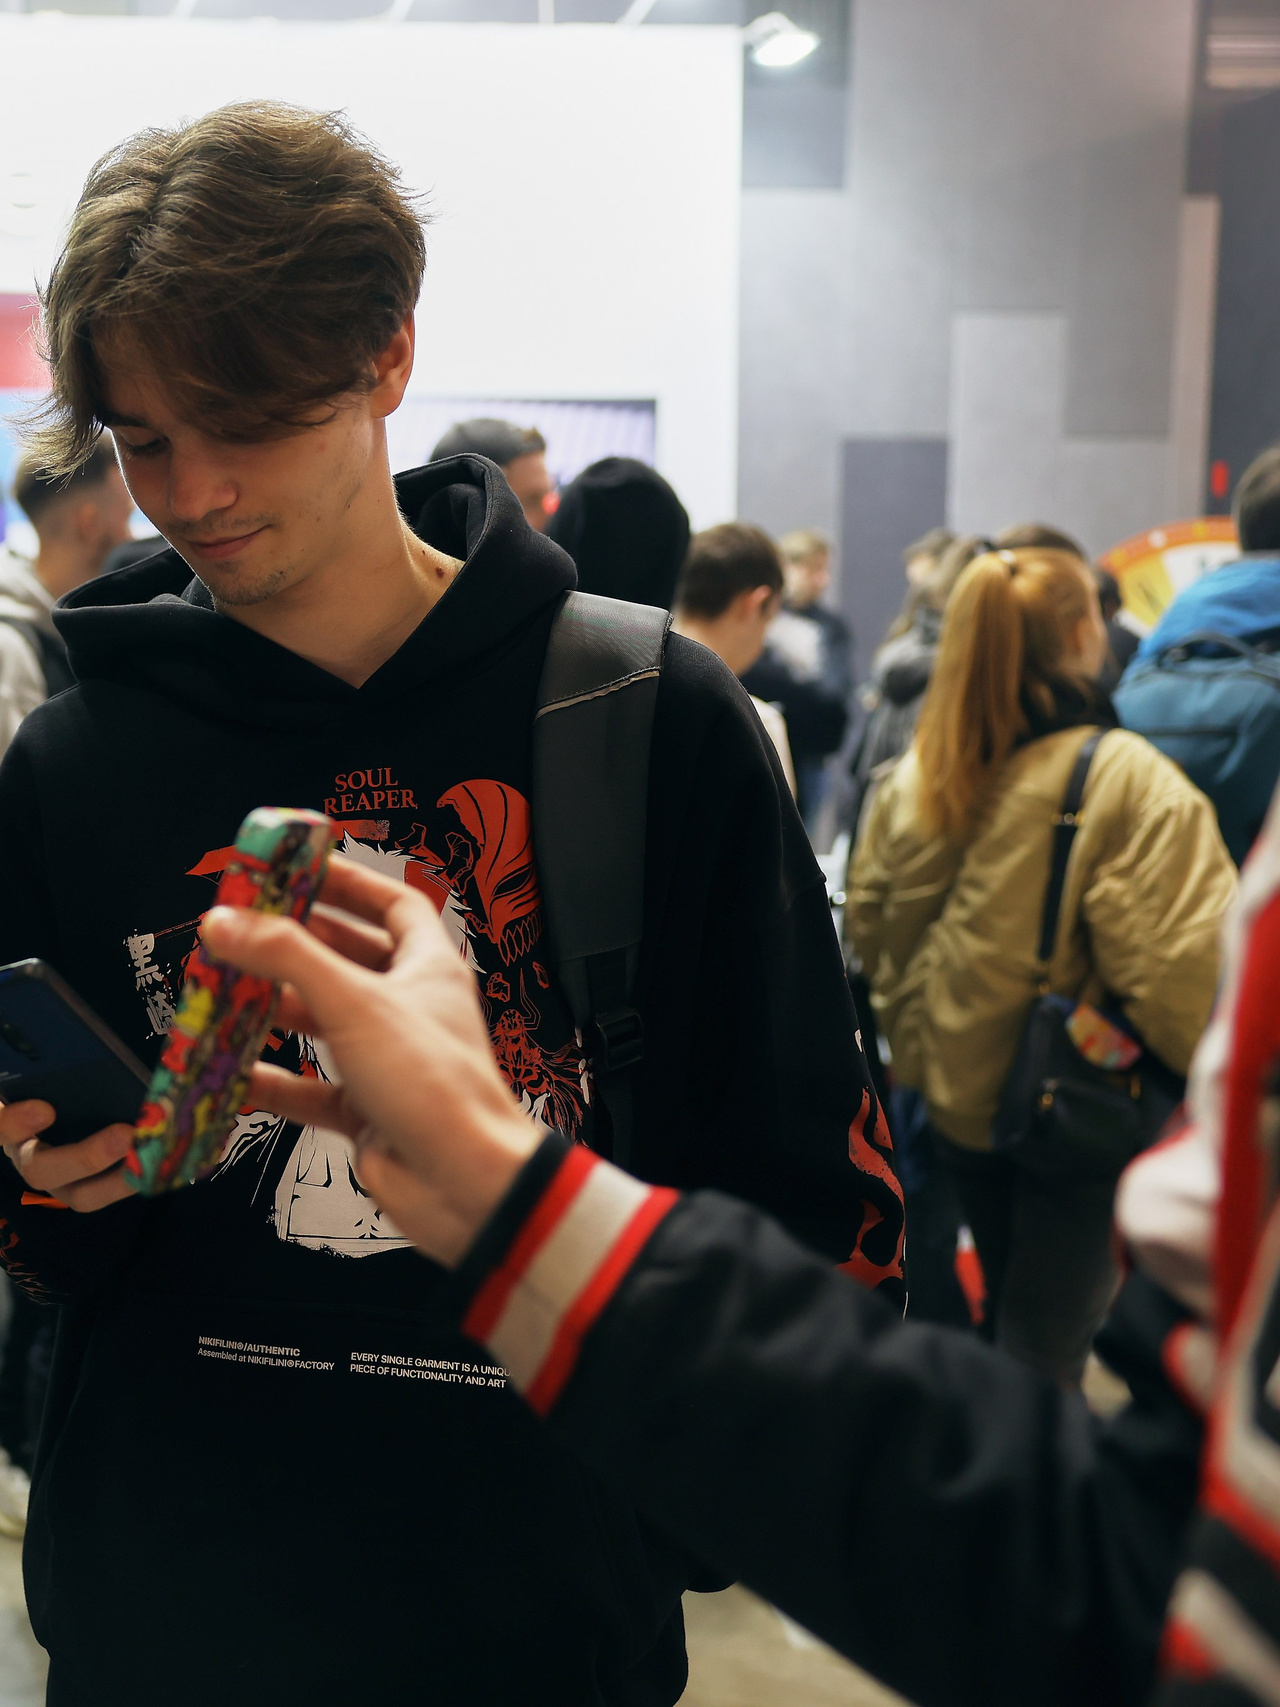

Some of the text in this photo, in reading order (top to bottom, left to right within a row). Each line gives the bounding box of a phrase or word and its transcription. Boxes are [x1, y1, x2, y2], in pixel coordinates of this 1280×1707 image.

[335, 767, 398, 792] SOUL
[197, 1347, 238, 1361] Assembled
[238, 1353, 247, 1362] at
[350, 1352, 511, 1378] EVERY SINGLE GARMENT IS A UNIQU
[350, 1363, 507, 1389] PIECE OF FUNCTIONALITY AND ART
